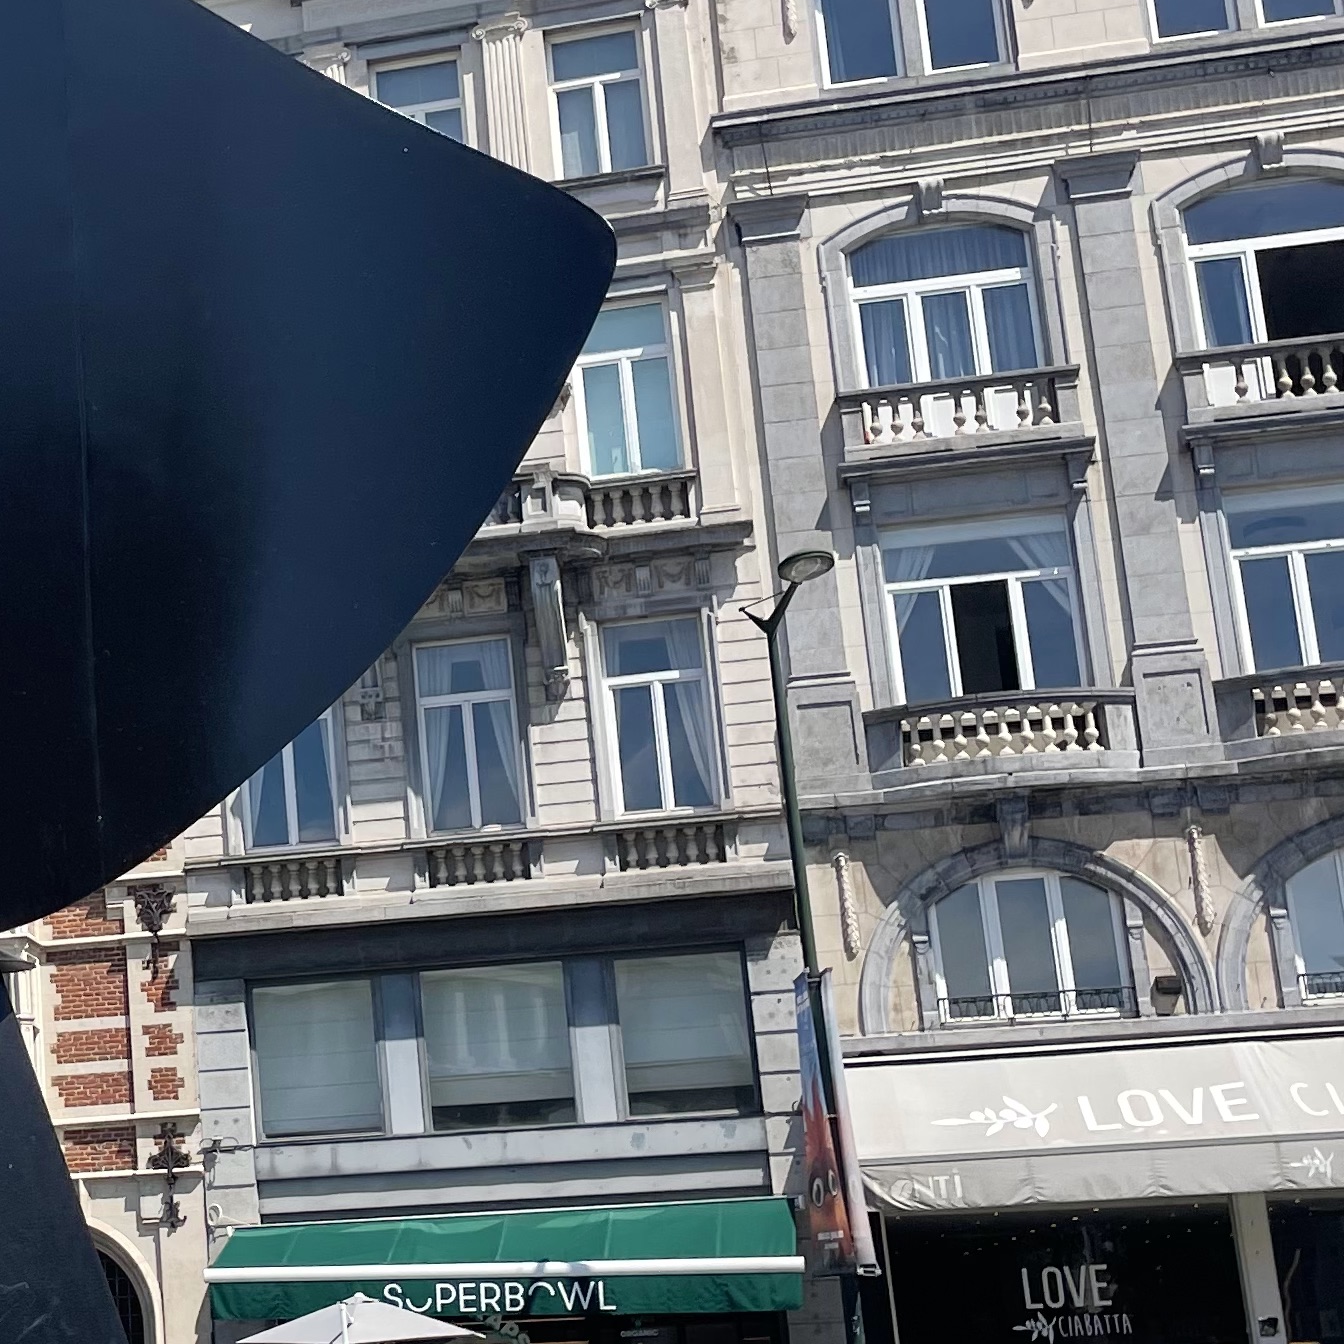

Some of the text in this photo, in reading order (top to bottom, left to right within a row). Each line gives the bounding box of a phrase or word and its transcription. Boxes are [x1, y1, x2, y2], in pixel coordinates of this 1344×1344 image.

[1076, 1081, 1260, 1131] LOVE
[383, 1281, 617, 1313] SUPERBOWL
[1021, 1263, 1113, 1310] LOVE
[1058, 1312, 1133, 1338] CIABATTA
